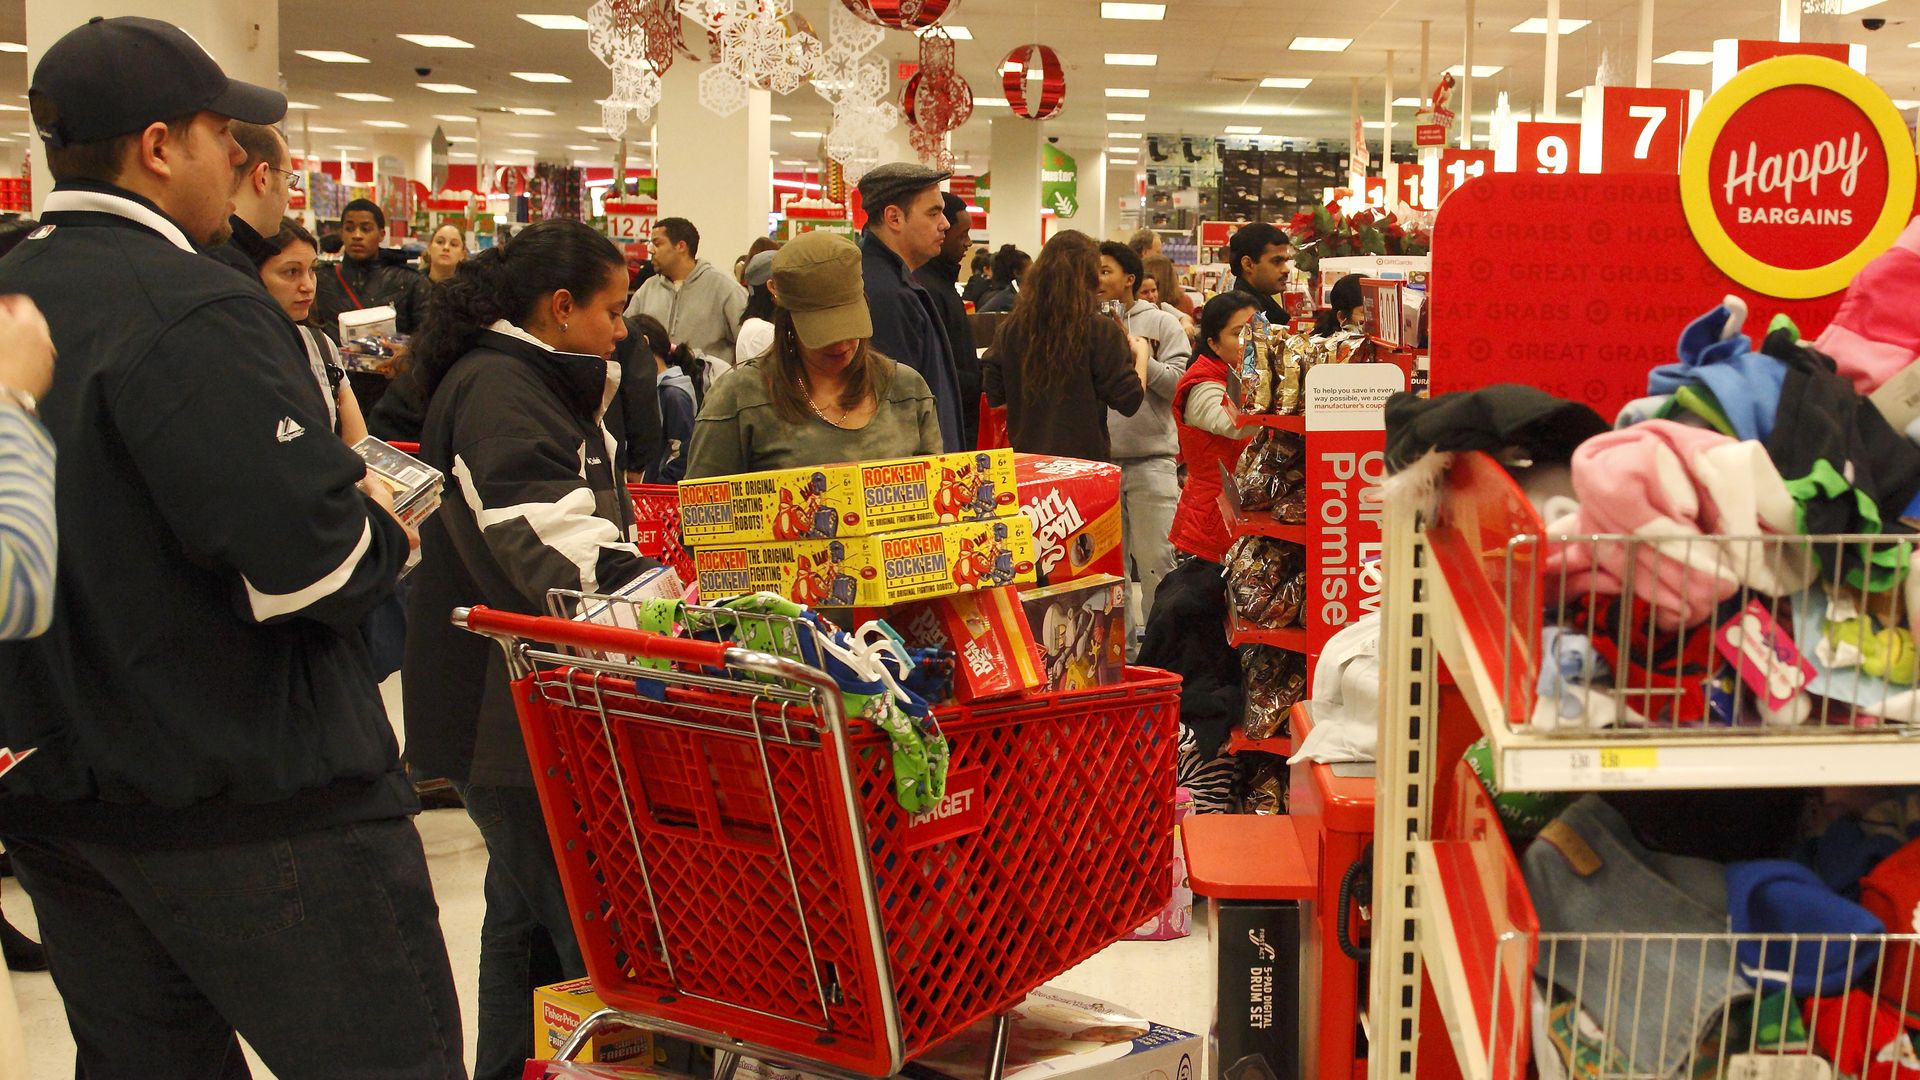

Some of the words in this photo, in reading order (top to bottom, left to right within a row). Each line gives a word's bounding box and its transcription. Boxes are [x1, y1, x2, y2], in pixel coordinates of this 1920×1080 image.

[1628, 106, 1667, 159] 7
[1536, 135, 1568, 174] 9
[1723, 131, 1868, 205] Happy
[1511, 183, 1594, 202] GREAT
[1602, 185, 1680, 204] GRAB
[1738, 207, 1852, 226] BARGAINS
[1487, 223, 1574, 242] GRABS
[1509, 263, 1591, 282] GREAT
[1600, 264, 1686, 284] GRABS
[1486, 303, 1572, 320] GRABS
[1507, 342, 1590, 361] GREAT
[1322, 387, 1337, 395] help
[1329, 395, 1360, 403] possible,
[864, 463, 925, 488] ROCK'EM
[1001, 476, 1007, 484] 2
[681, 482, 729, 505] ROCK'EM
[731, 481, 743, 497] THE
[745, 478, 777, 496] ORIGINAL
[866, 483, 927, 506] SOCK'EM
[1358, 451, 1384, 530] Our
[684, 504, 732, 526] SOCK'EM
[732, 497, 763, 514] FIGHTING
[1018, 486, 1067, 536] Dirt
[734, 514, 764, 531] ROBOTS!
[1015, 529, 1024, 537] 6+
[637, 530, 657, 544] GET
[883, 533, 943, 559] ROCK'EM
[1321, 453, 1356, 626] Promise
[697, 550, 747, 571] ROCK'EM
[747, 549, 761, 564] THE
[762, 547, 795, 564] ORIGINAL
[749, 566, 782, 582] FIGHTING
[885, 554, 945, 579] SOCK'EM
[699, 570, 750, 592] SOCK'EM
[1250, 967, 1263, 1002] DRUM
[1263, 967, 1273, 994] 5-PAD
[1250, 1006, 1263, 1029] SET
[1263, 995, 1273, 1029] DIGITAL
